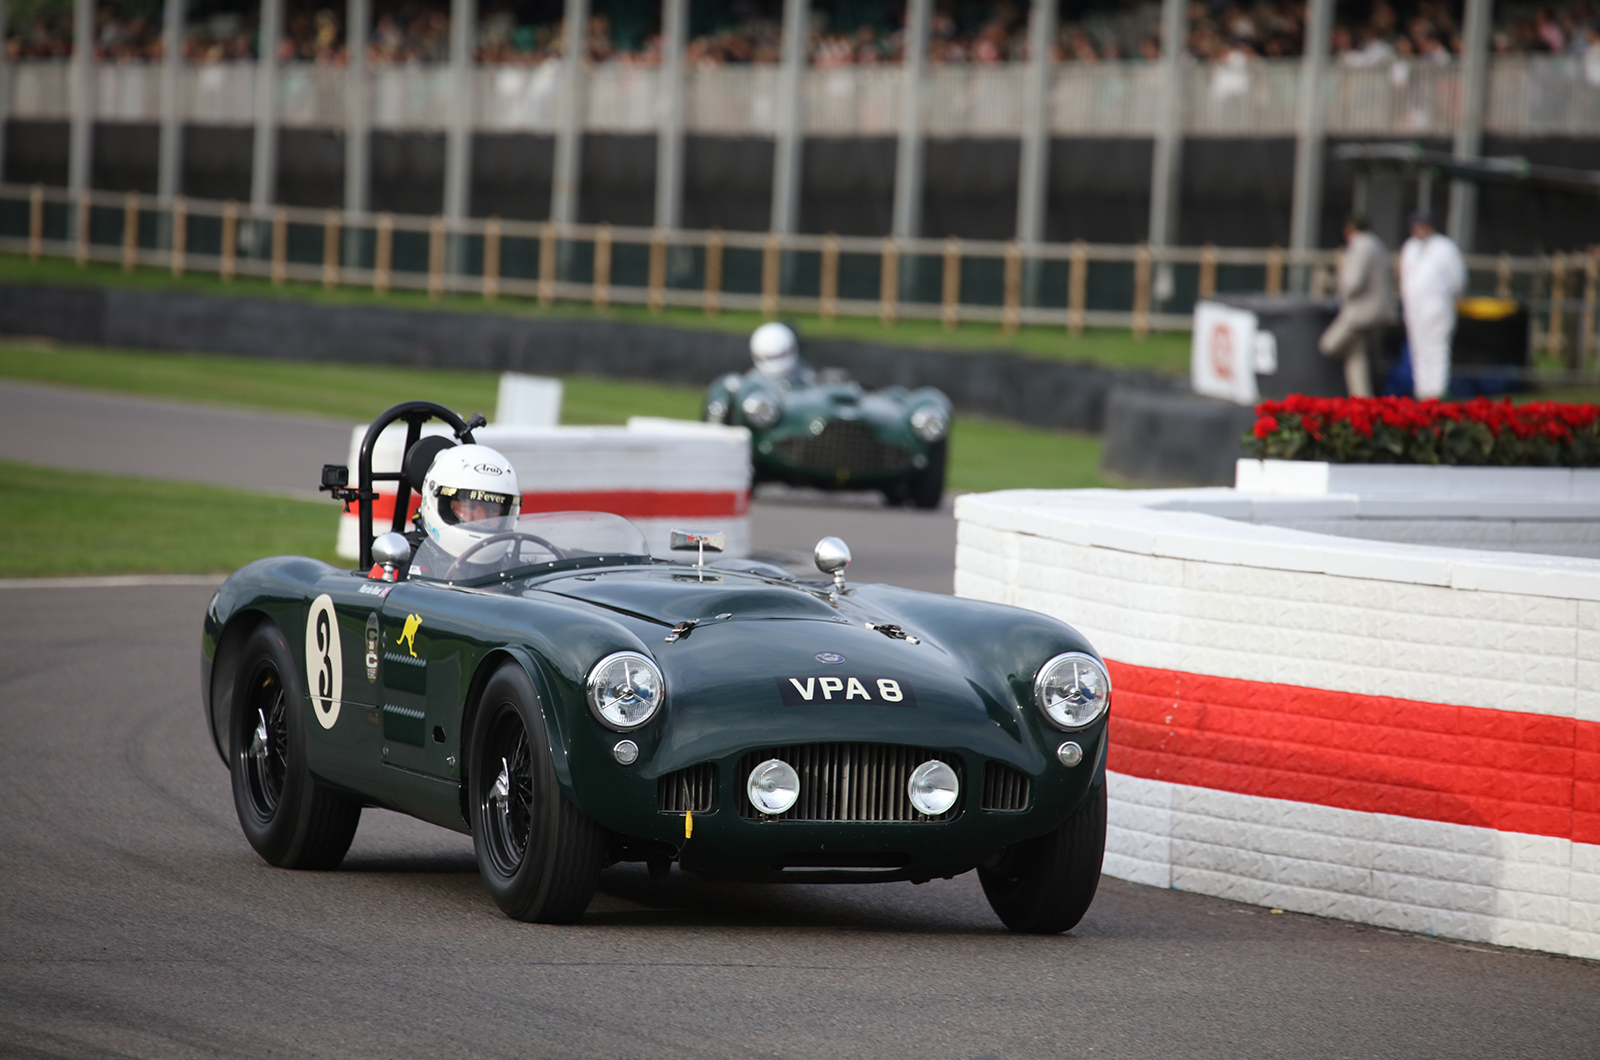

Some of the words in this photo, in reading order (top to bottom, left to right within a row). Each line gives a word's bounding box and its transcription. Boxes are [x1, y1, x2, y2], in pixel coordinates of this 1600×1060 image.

[480, 464, 499, 474] Arai
[470, 490, 506, 504] #Fever
[316, 608, 333, 714] 3
[366, 653, 378, 668] C
[788, 677, 872, 701] VPA
[876, 678, 904, 703] 8
